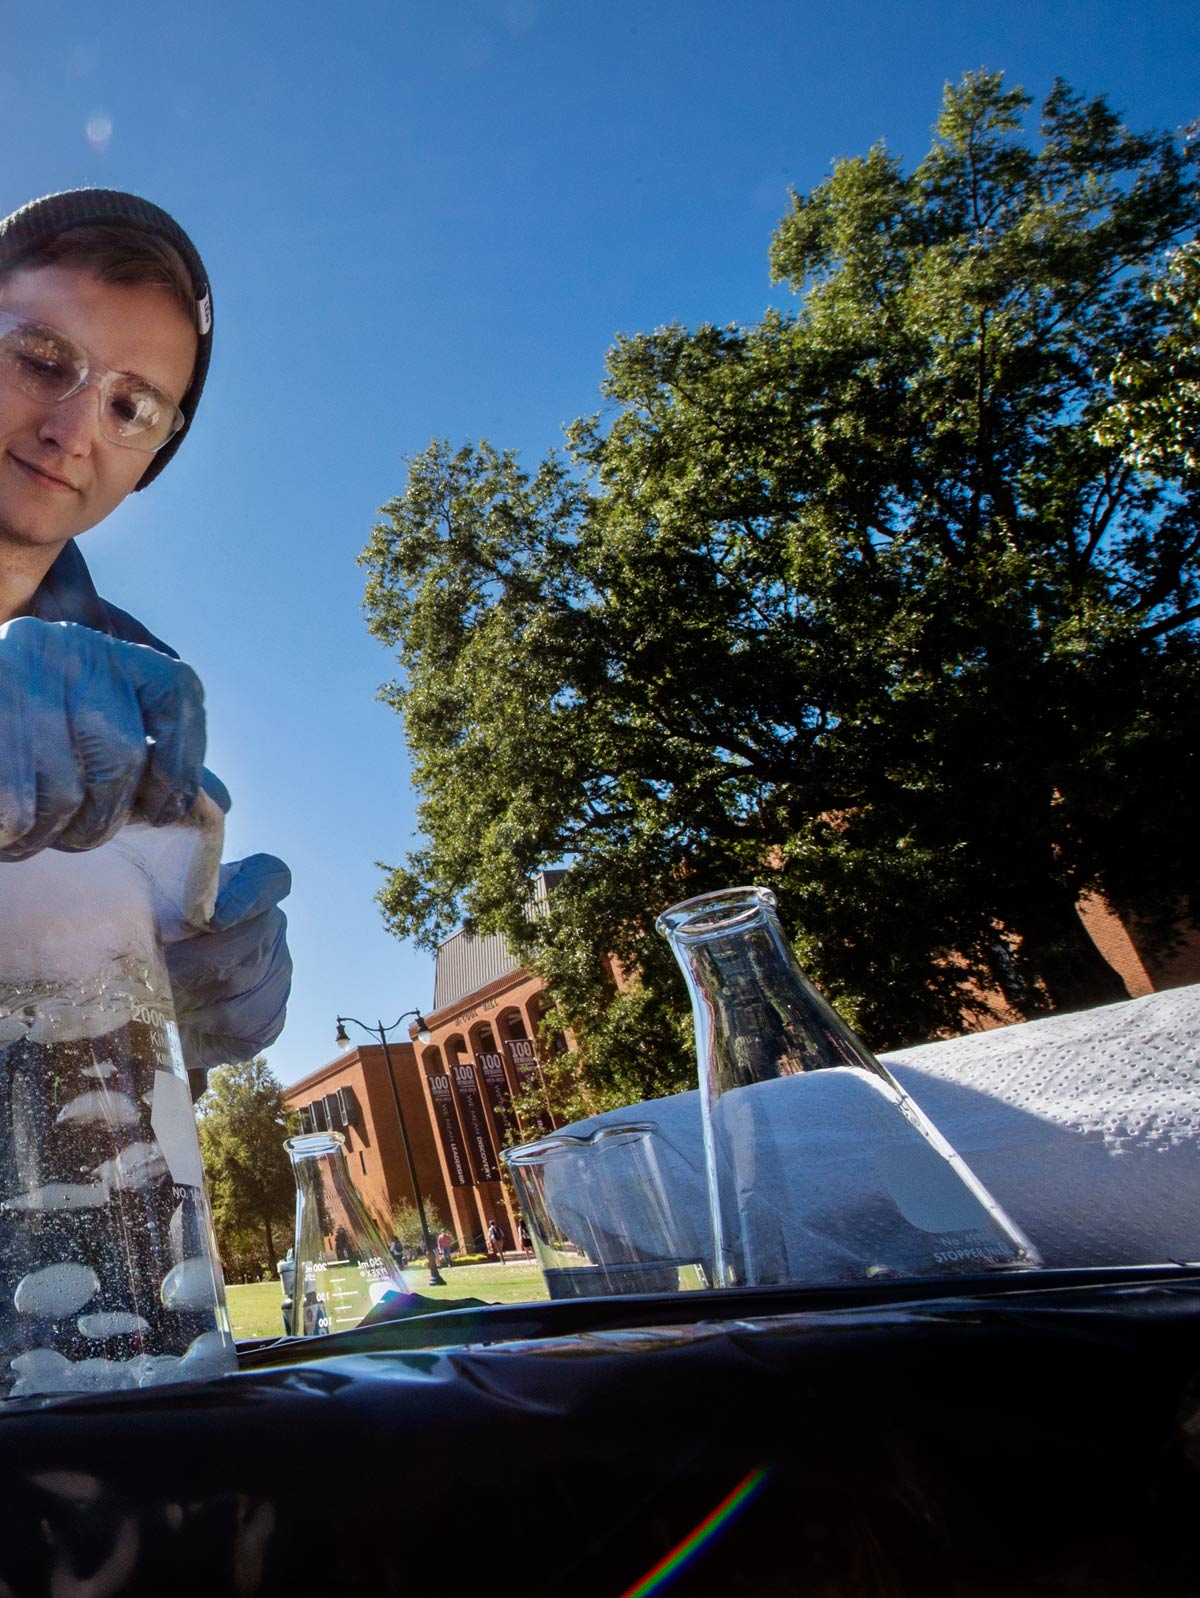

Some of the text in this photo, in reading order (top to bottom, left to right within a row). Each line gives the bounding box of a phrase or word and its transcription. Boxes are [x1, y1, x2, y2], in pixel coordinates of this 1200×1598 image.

[509, 1041, 532, 1058] 100
[480, 1053, 501, 1070] 100
[453, 1065, 473, 1080] 100
[429, 1076, 449, 1090] 100
[933, 1247, 985, 1264] STOPPER
